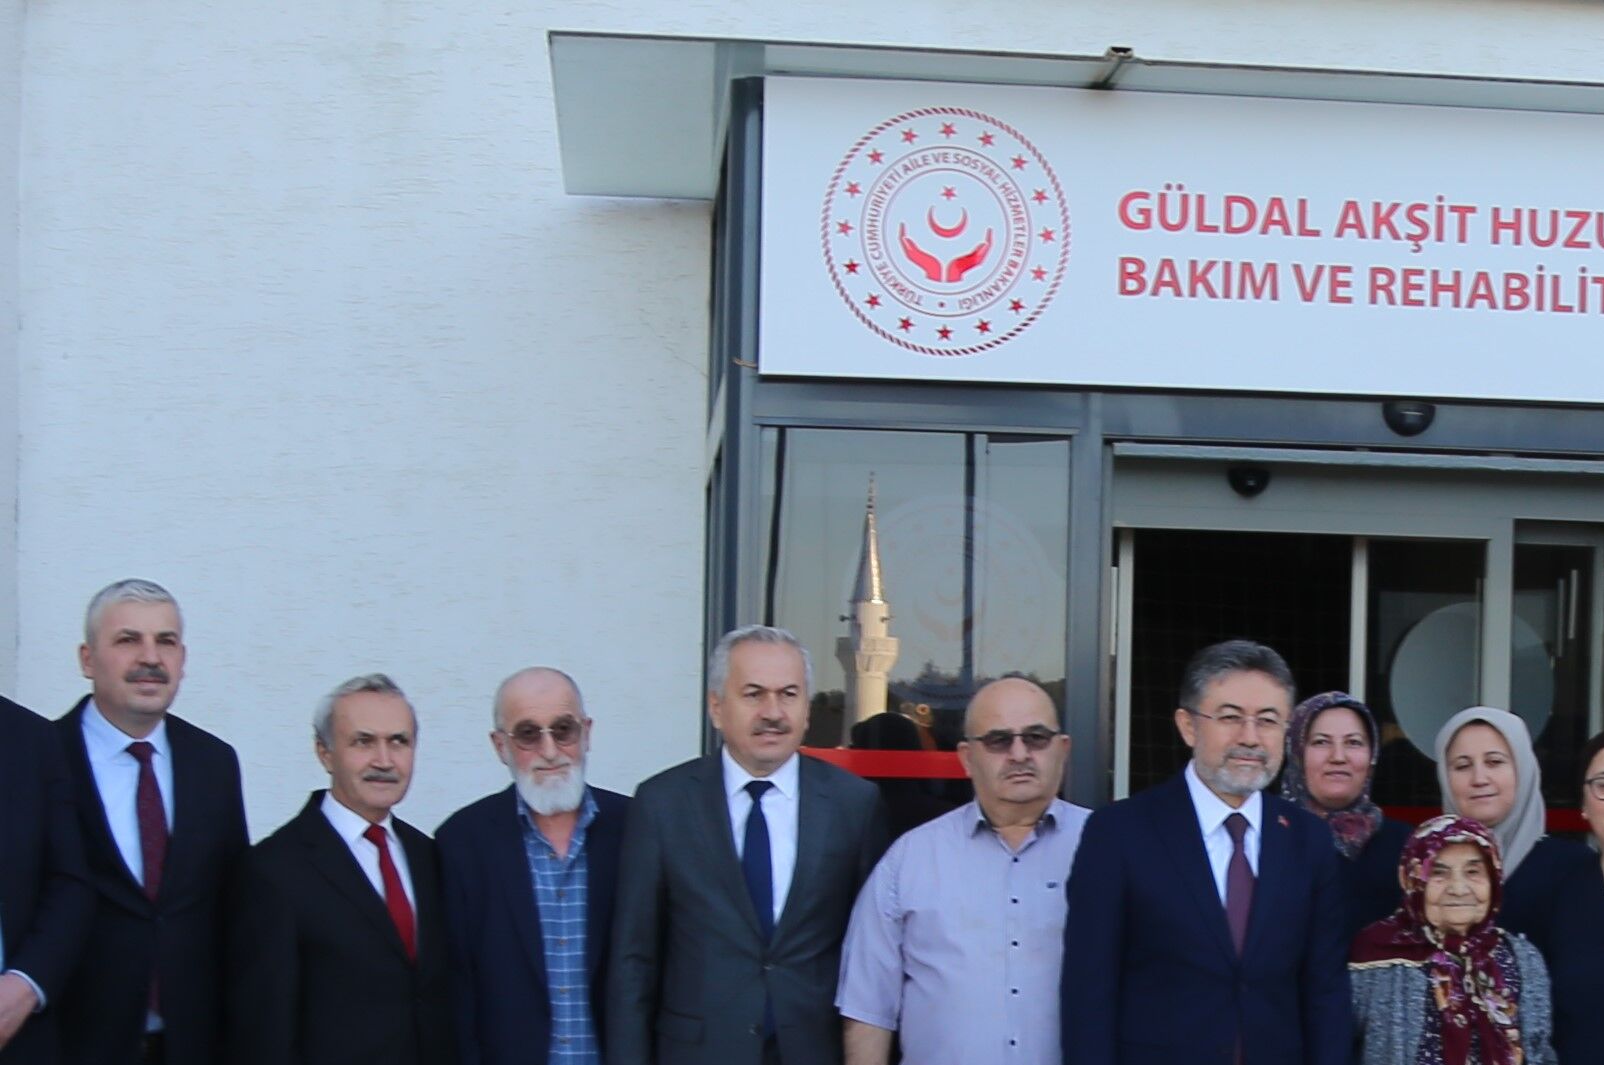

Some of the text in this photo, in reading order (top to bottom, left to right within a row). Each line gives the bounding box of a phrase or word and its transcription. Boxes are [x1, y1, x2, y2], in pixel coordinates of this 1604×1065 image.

[901, 153, 931, 175] AİLE
[931, 152, 950, 164] VE
[952, 152, 999, 185] SOSYAL
[1117, 183, 1323, 239] GÜLDAL
[1335, 195, 1479, 252] AKŞİT
[1118, 256, 1280, 302] BAKIM
[1292, 263, 1354, 305] VE
